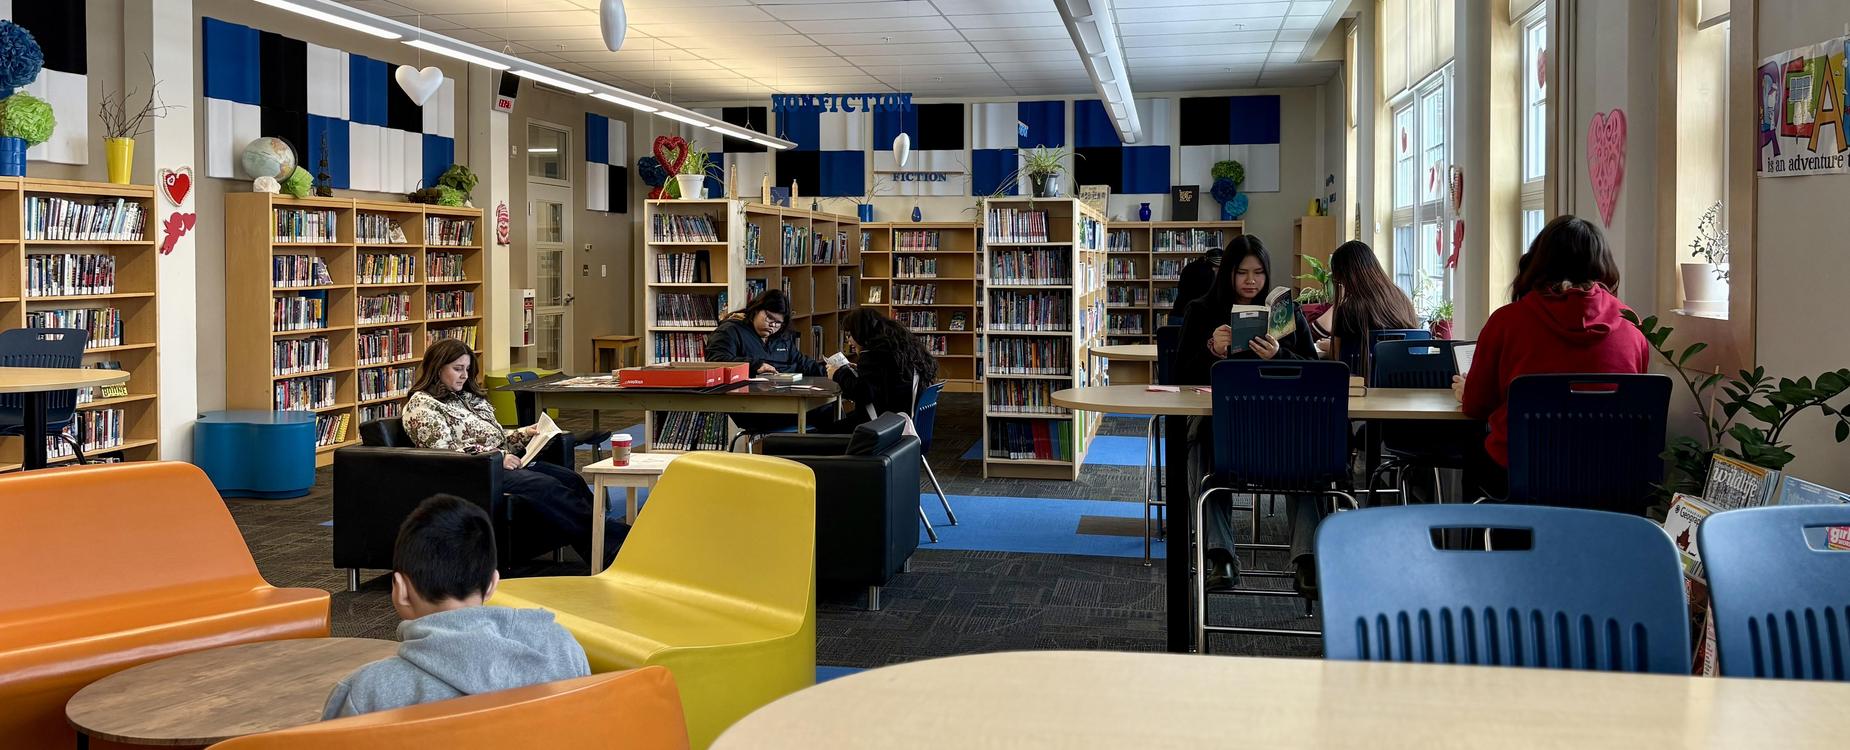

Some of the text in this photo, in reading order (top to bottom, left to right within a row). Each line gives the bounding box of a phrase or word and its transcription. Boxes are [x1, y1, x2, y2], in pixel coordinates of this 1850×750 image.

[1757, 38, 1850, 172] REA
[893, 171, 947, 182] FICTION
[1767, 157, 1774, 173] is
[1775, 158, 1786, 172] an
[1788, 154, 1844, 172] adventure
[1713, 465, 1758, 499] wildlife
